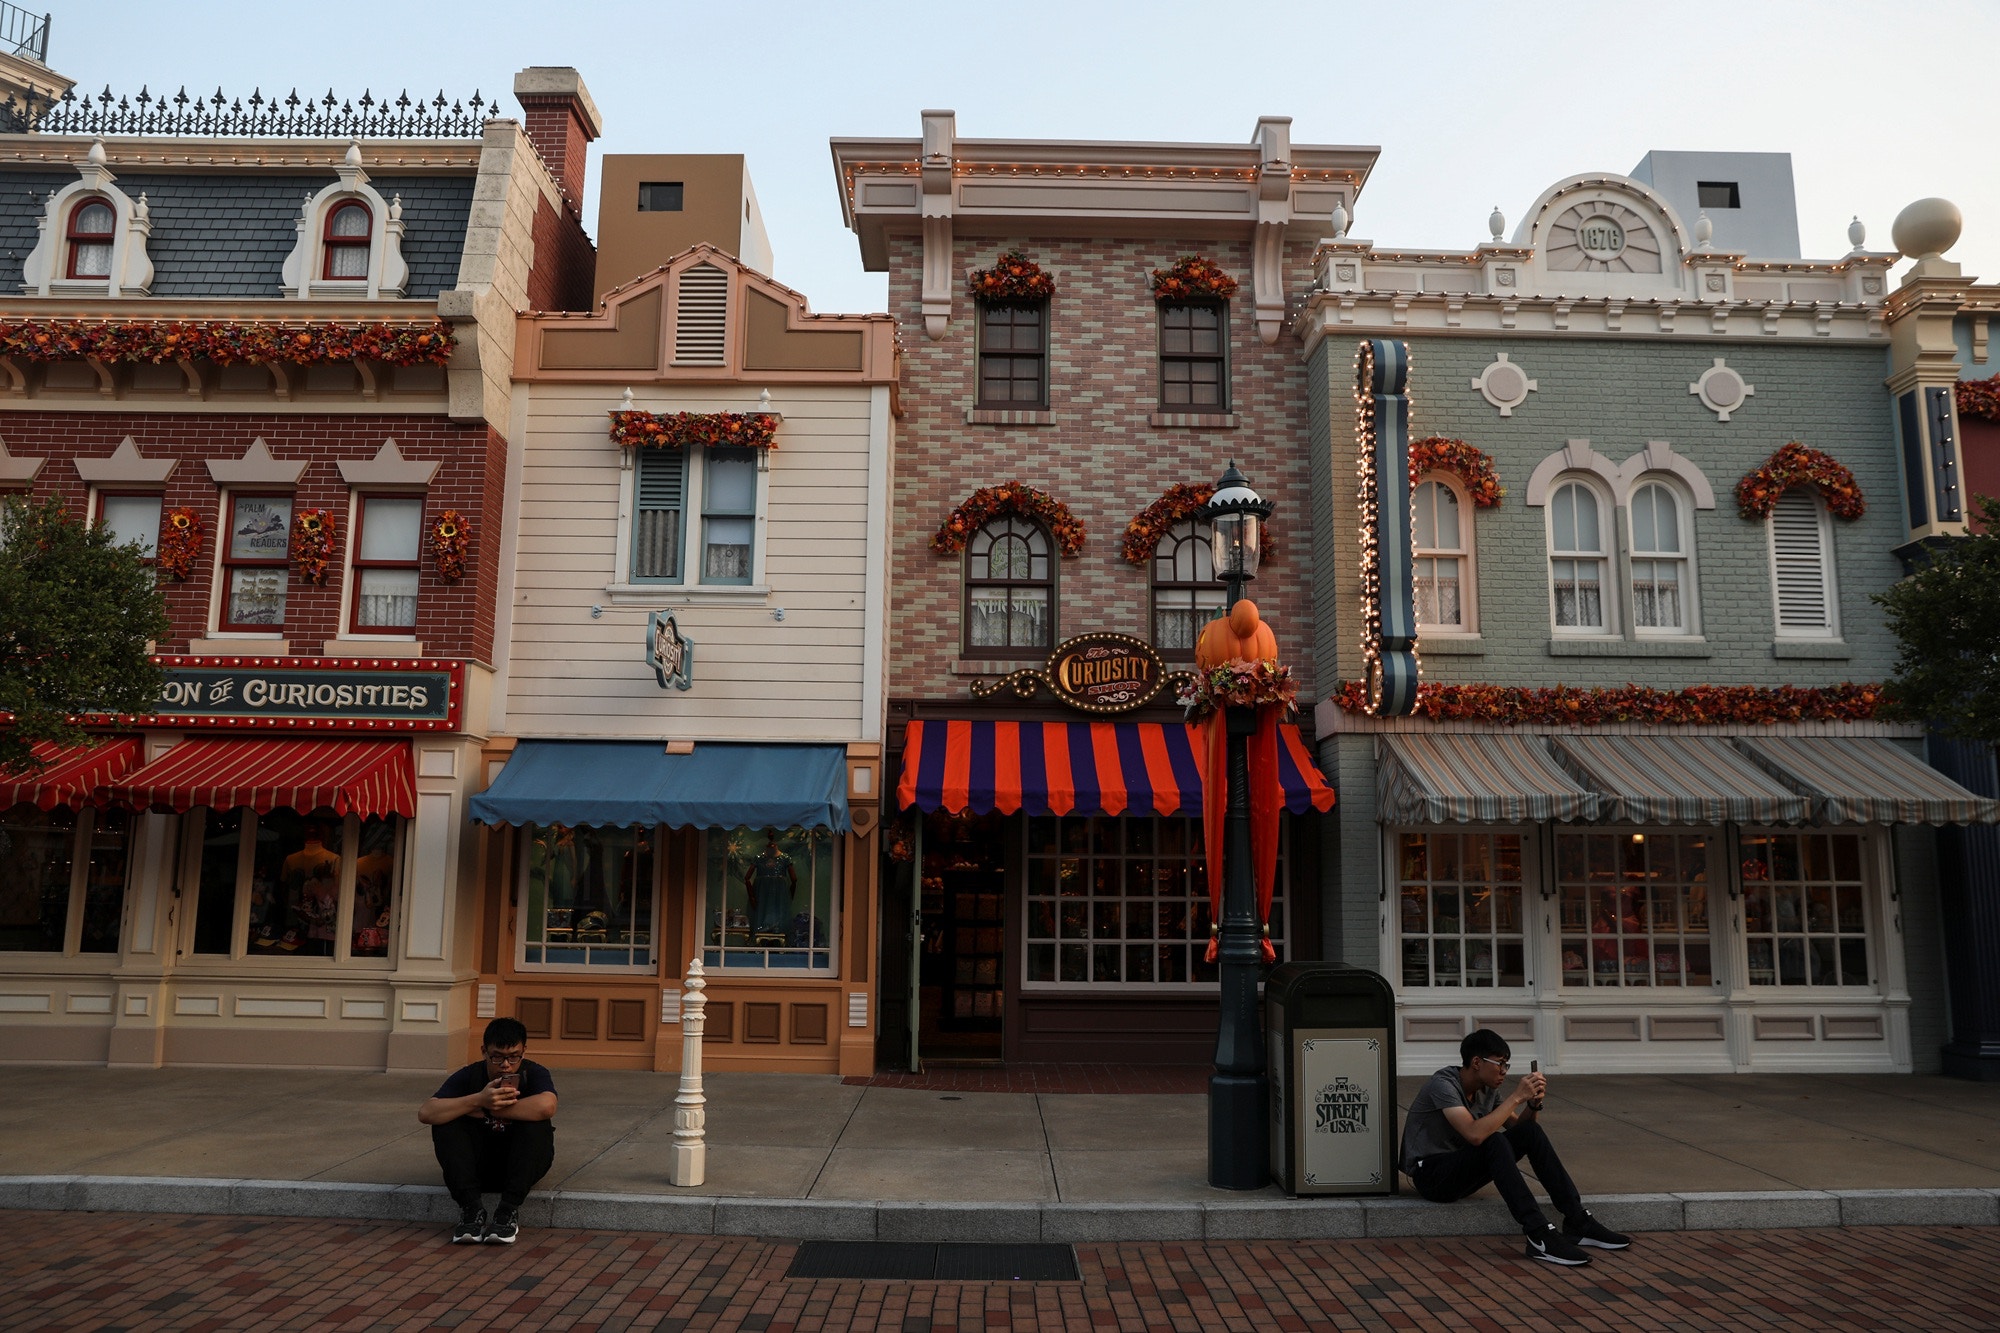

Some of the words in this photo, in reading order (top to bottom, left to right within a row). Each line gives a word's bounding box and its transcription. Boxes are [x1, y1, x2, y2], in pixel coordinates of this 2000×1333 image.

[1579, 227, 1620, 250] 1876
[244, 503, 266, 513] PALM
[250, 538, 287, 548] READERS
[976, 599, 1042, 627] NURSERY
[1085, 647, 1110, 660] The
[1058, 654, 1150, 694] CURIOSITY
[243, 679, 429, 709] CURIOSITIES
[1088, 681, 1141, 695] SHOP
[1323, 1093, 1361, 1103] MAIN
[1315, 1104, 1369, 1128] STREET
[1329, 1121, 1357, 1134] USA
